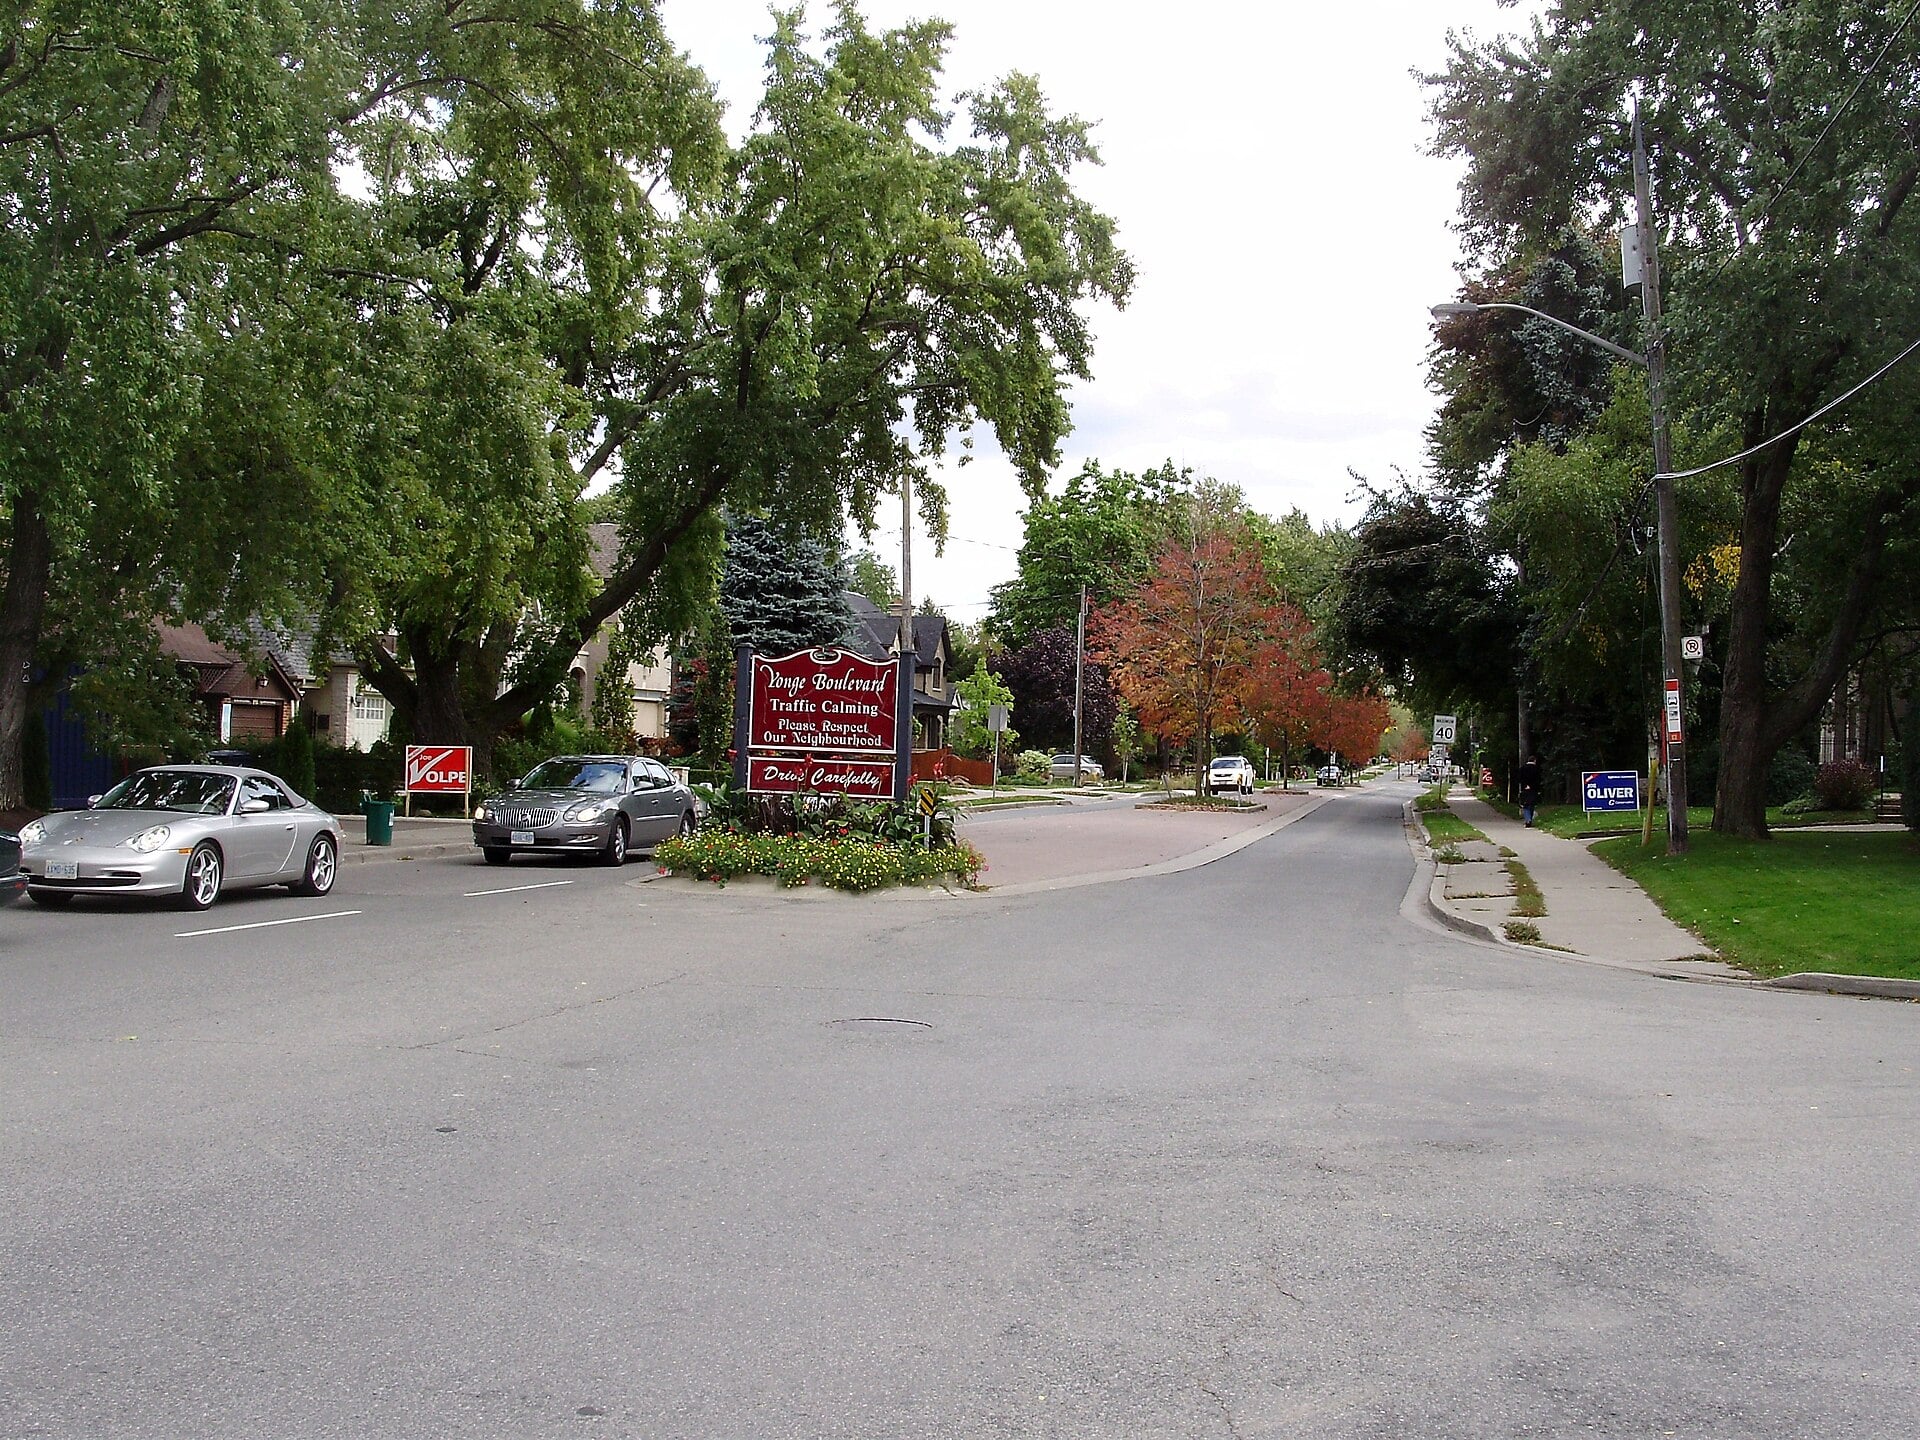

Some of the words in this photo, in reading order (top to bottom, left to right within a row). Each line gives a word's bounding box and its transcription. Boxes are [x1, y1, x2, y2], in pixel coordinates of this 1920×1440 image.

[760, 664, 806, 697] Yonge
[812, 668, 892, 692] Boulevard
[770, 698, 817, 713] Traffic
[821, 700, 879, 717] Calming
[778, 718, 816, 731] Please
[822, 720, 869, 734] Respect
[1436, 727, 1453, 739] 40
[763, 731, 787, 743] Our
[792, 731, 882, 747] Neighbourhood
[409, 749, 467, 785] VOLPE
[763, 765, 805, 781] Drive
[811, 767, 880, 789] Carefully
[1587, 788, 1634, 798] OLIVER
